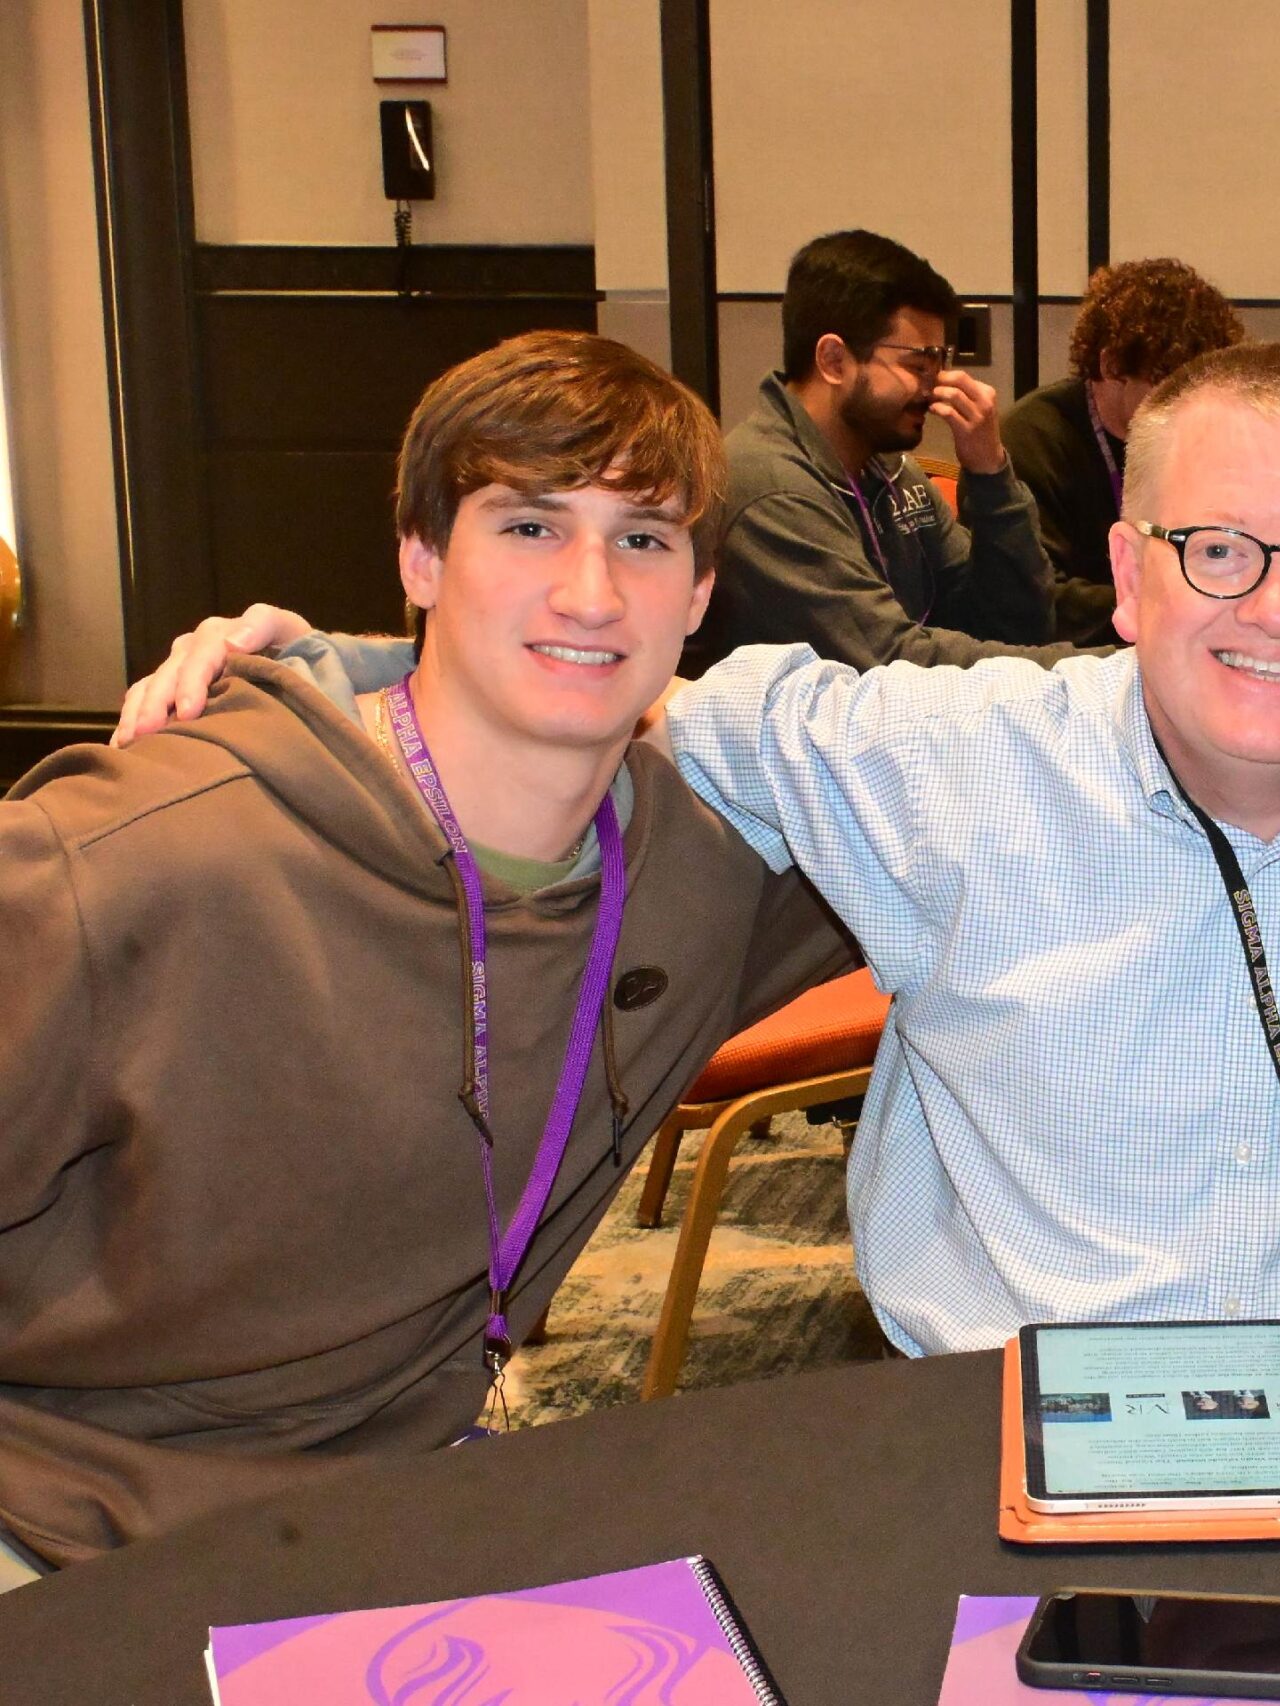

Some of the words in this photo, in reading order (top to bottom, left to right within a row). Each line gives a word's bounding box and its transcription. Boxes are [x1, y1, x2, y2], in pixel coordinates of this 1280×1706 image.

[387, 692, 422, 757] ALPHA
[410, 759, 468, 853] EPSILON
[471, 961, 487, 1037] SIGMA
[1233, 889, 1264, 963] SIGMA
[1253, 967, 1280, 1039] ALPHA
